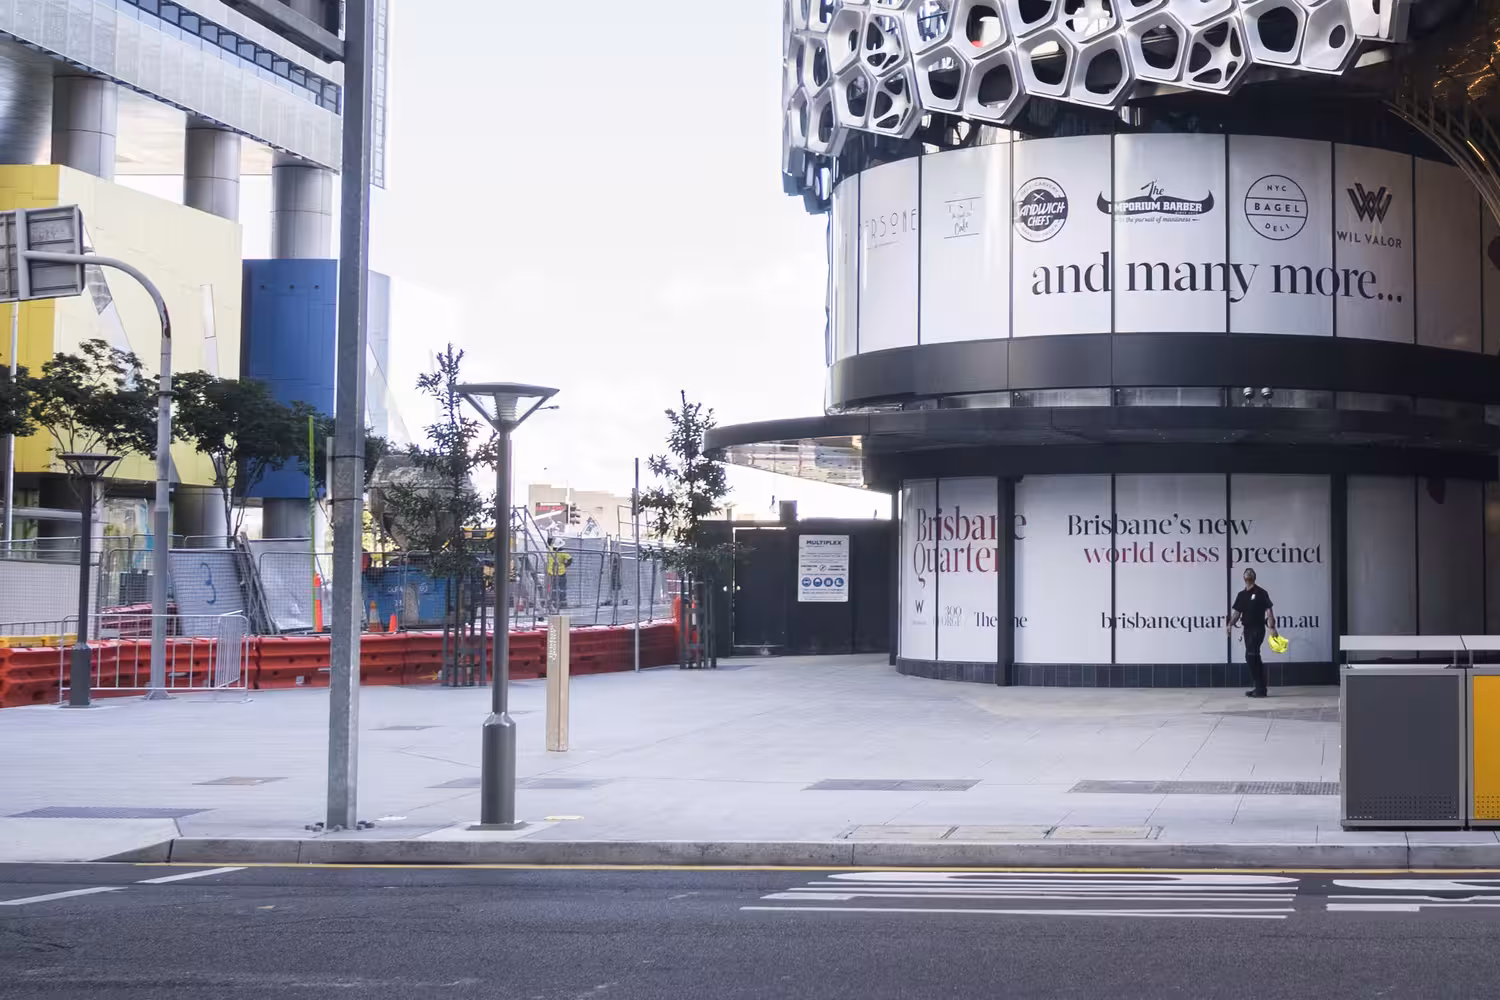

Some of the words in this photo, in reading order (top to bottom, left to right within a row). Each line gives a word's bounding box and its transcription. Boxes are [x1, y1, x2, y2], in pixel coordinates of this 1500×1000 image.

[1140, 178, 1165, 197] The
[1266, 184, 1287, 192] NYC
[1014, 201, 1066, 221] SANDWICH
[1163, 201, 1203, 212] BARBER
[1254, 202, 1300, 213] BAGEL
[1027, 215, 1050, 227] CHEFS
[1265, 222, 1290, 232] DELI
[1336, 231, 1361, 243] WIL
[1365, 234, 1402, 248] VALOR
[1031, 251, 1112, 296] and
[1125, 260, 1260, 303] many
[1270, 262, 1403, 303] more...
[1197, 517, 1253, 536] new
[1084, 541, 1154, 564] world
[1161, 541, 1219, 564] class
[1229, 542, 1325, 568] precinct
[915, 599, 924, 614] W
[974, 611, 998, 628] The
[739, 872, 1300, 919] ONLY
